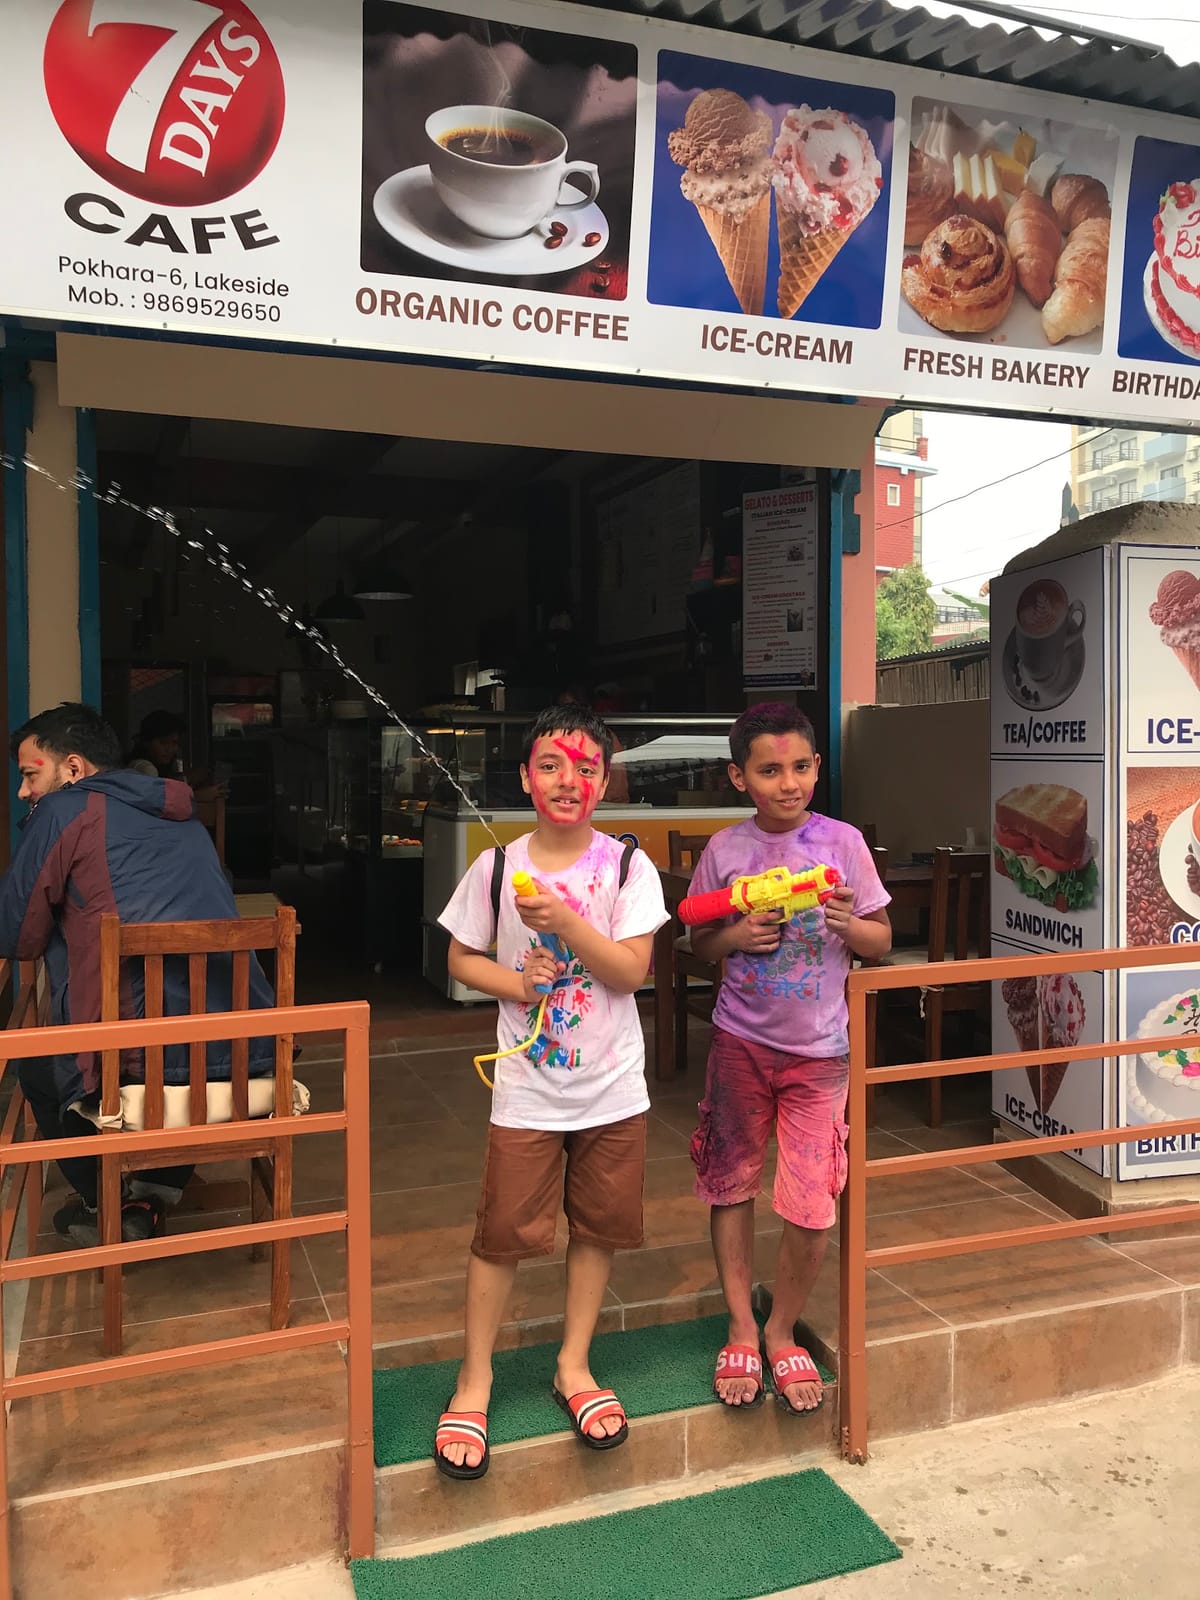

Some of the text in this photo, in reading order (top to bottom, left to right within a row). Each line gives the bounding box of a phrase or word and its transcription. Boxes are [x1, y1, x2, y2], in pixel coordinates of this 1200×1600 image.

[86, 0, 261, 178] 7 DAYS
[64, 192, 281, 255] CAFE
[58, 255, 290, 298] Pokhara-6, Lakeside
[68, 285, 125, 308] Mob.
[143, 292, 282, 323] 9869529650
[355, 286, 630, 342] ORGANIC COFFEE
[701, 324, 854, 364] ICE-CREAM
[903, 347, 1090, 389] FRESH BAKERY
[745, 495, 771, 510] GELATO
[779, 490, 814, 506] DESSERTS
[1003, 716, 1087, 748] TEA/COFFEE
[1005, 908, 1083, 948] SANDWICH
